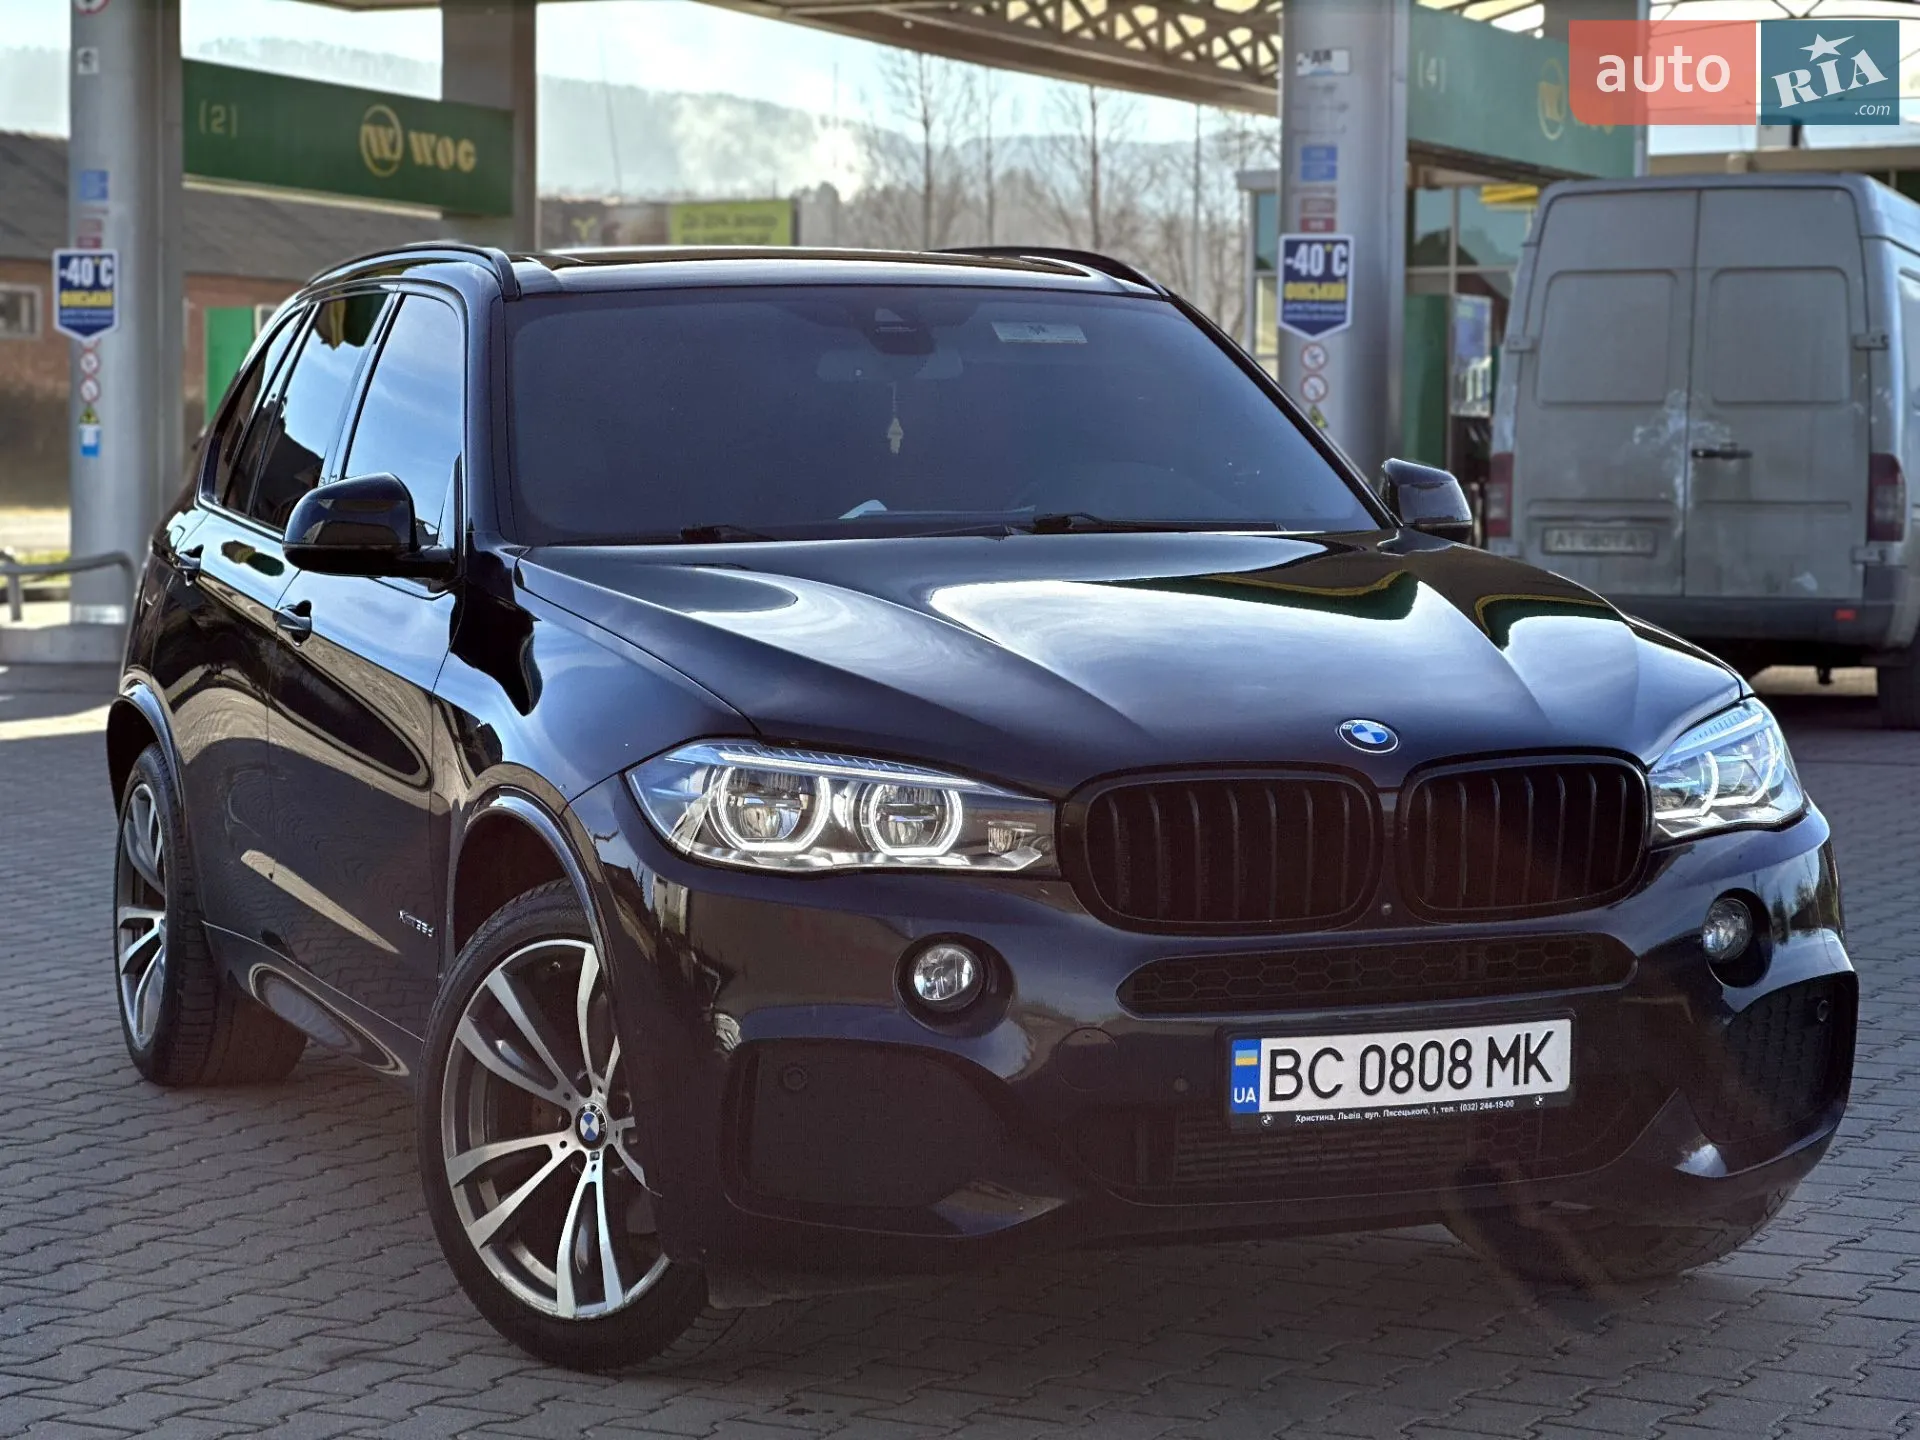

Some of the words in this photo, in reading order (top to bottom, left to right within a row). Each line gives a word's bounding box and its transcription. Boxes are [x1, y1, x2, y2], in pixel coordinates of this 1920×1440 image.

[200, 101, 238, 138] (2)
[408, 129, 477, 174] WOG
[1268, 1047, 1345, 1102] BC
[1359, 1038, 1472, 1096] 0808
[1486, 1030, 1555, 1088] MK
[1233, 1087, 1257, 1104] UA
[1295, 1114, 1336, 1124] Христина,
[1460, 1102, 1478, 1112] (032)
